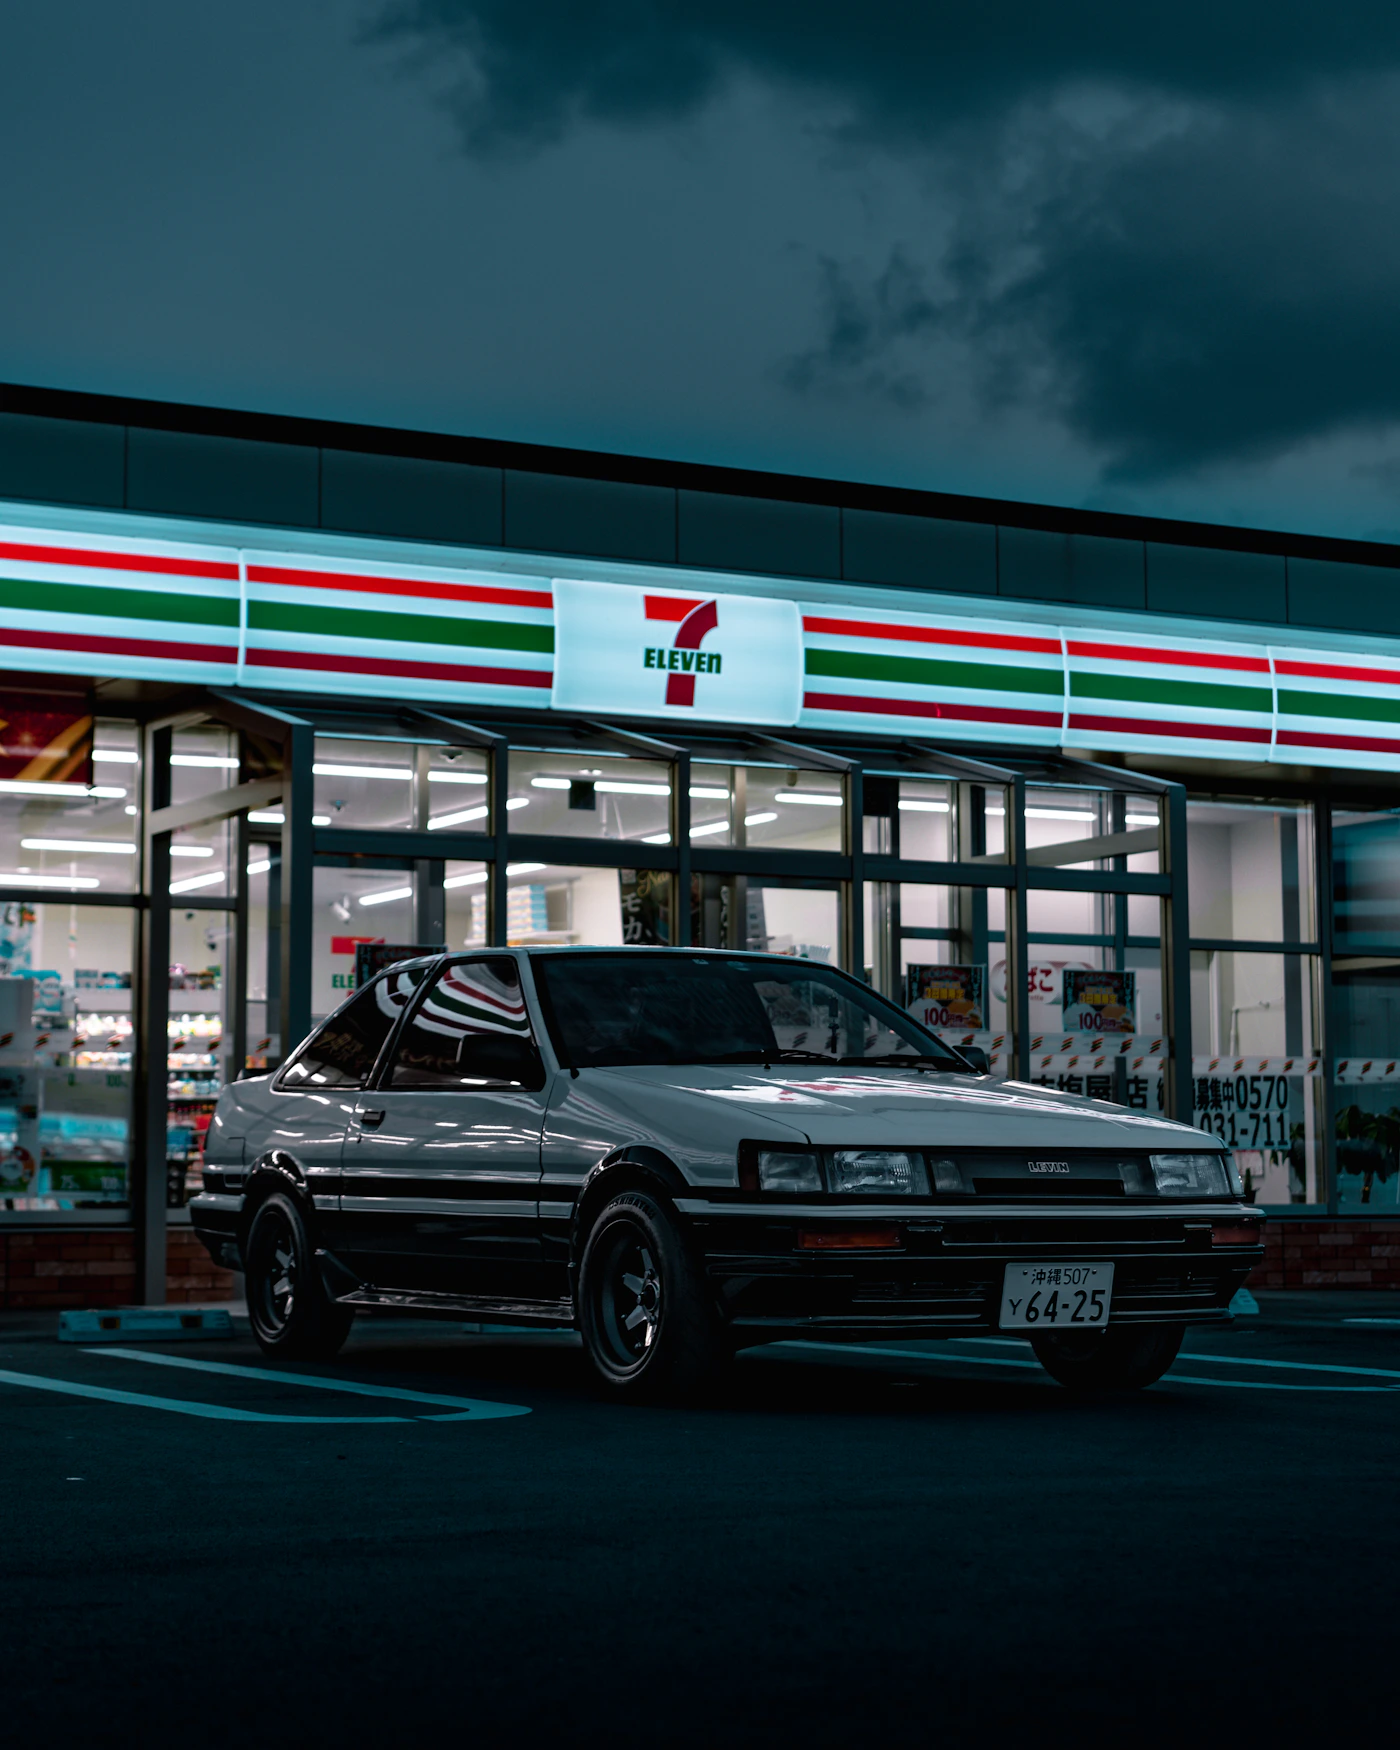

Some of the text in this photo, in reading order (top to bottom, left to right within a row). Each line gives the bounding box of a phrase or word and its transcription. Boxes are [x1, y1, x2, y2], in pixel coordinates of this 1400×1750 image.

[643, 594, 718, 707] 7
[331, 974, 355, 989] ELE
[1235, 1075, 1288, 1110] 0570
[1028, 1161, 1070, 1173] LEVIN
[1009, 1289, 1106, 1323] Y 64-25
